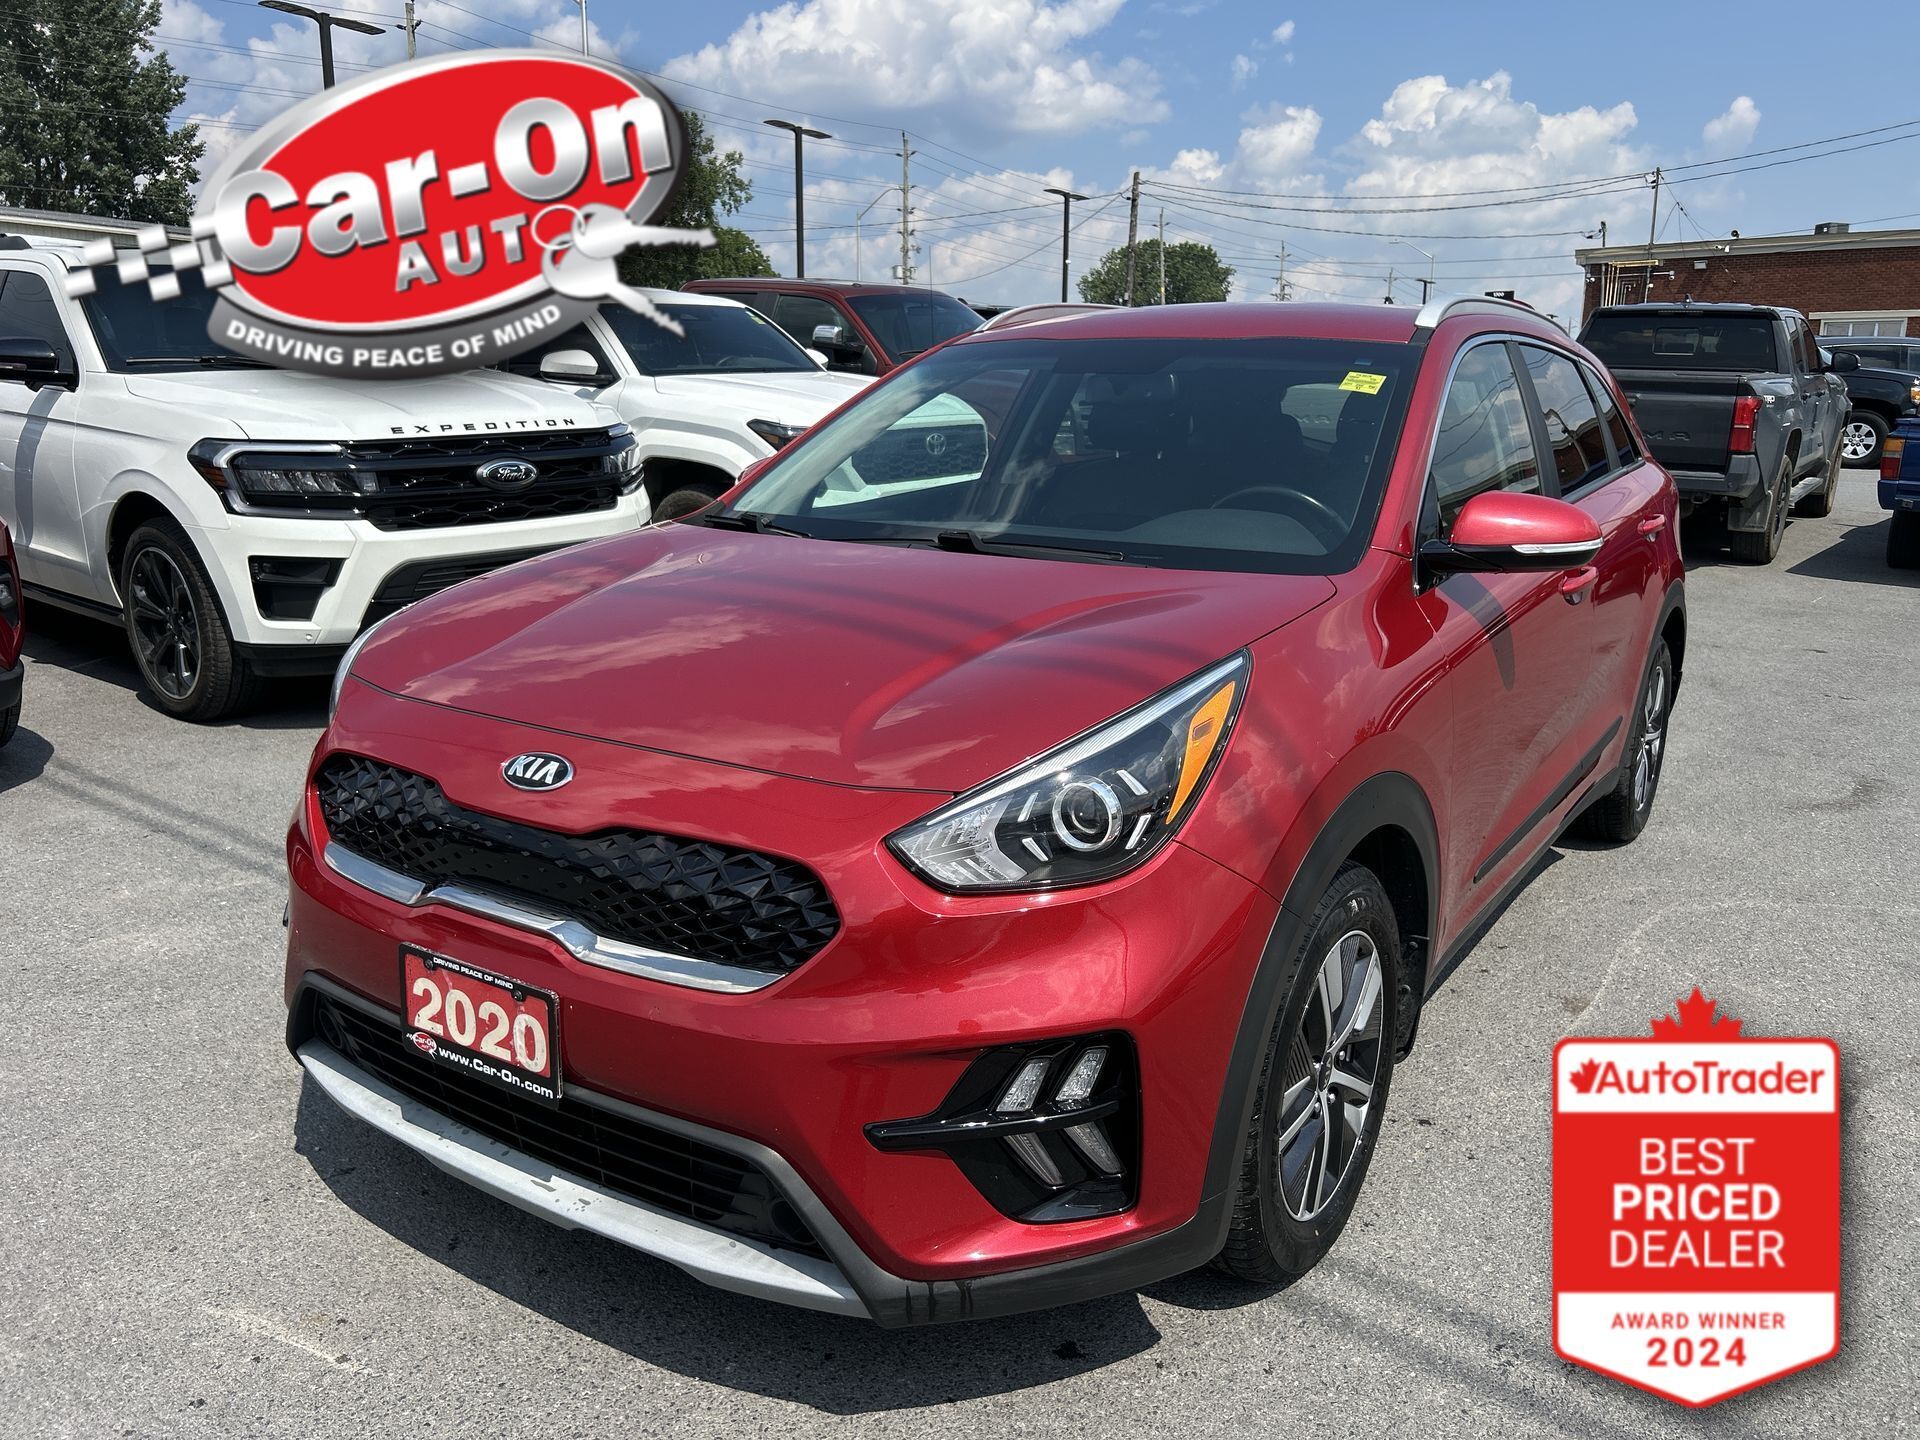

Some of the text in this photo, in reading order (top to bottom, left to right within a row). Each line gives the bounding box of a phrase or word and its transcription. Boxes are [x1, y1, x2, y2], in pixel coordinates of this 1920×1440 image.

[390, 418, 576, 435] EXPEDITION
[507, 755, 560, 784] KIA
[433, 956, 514, 989] DRIVING PEACE OF MIND
[412, 977, 547, 1073] 2020
[438, 1047, 554, 1099] www.Car-On.com
